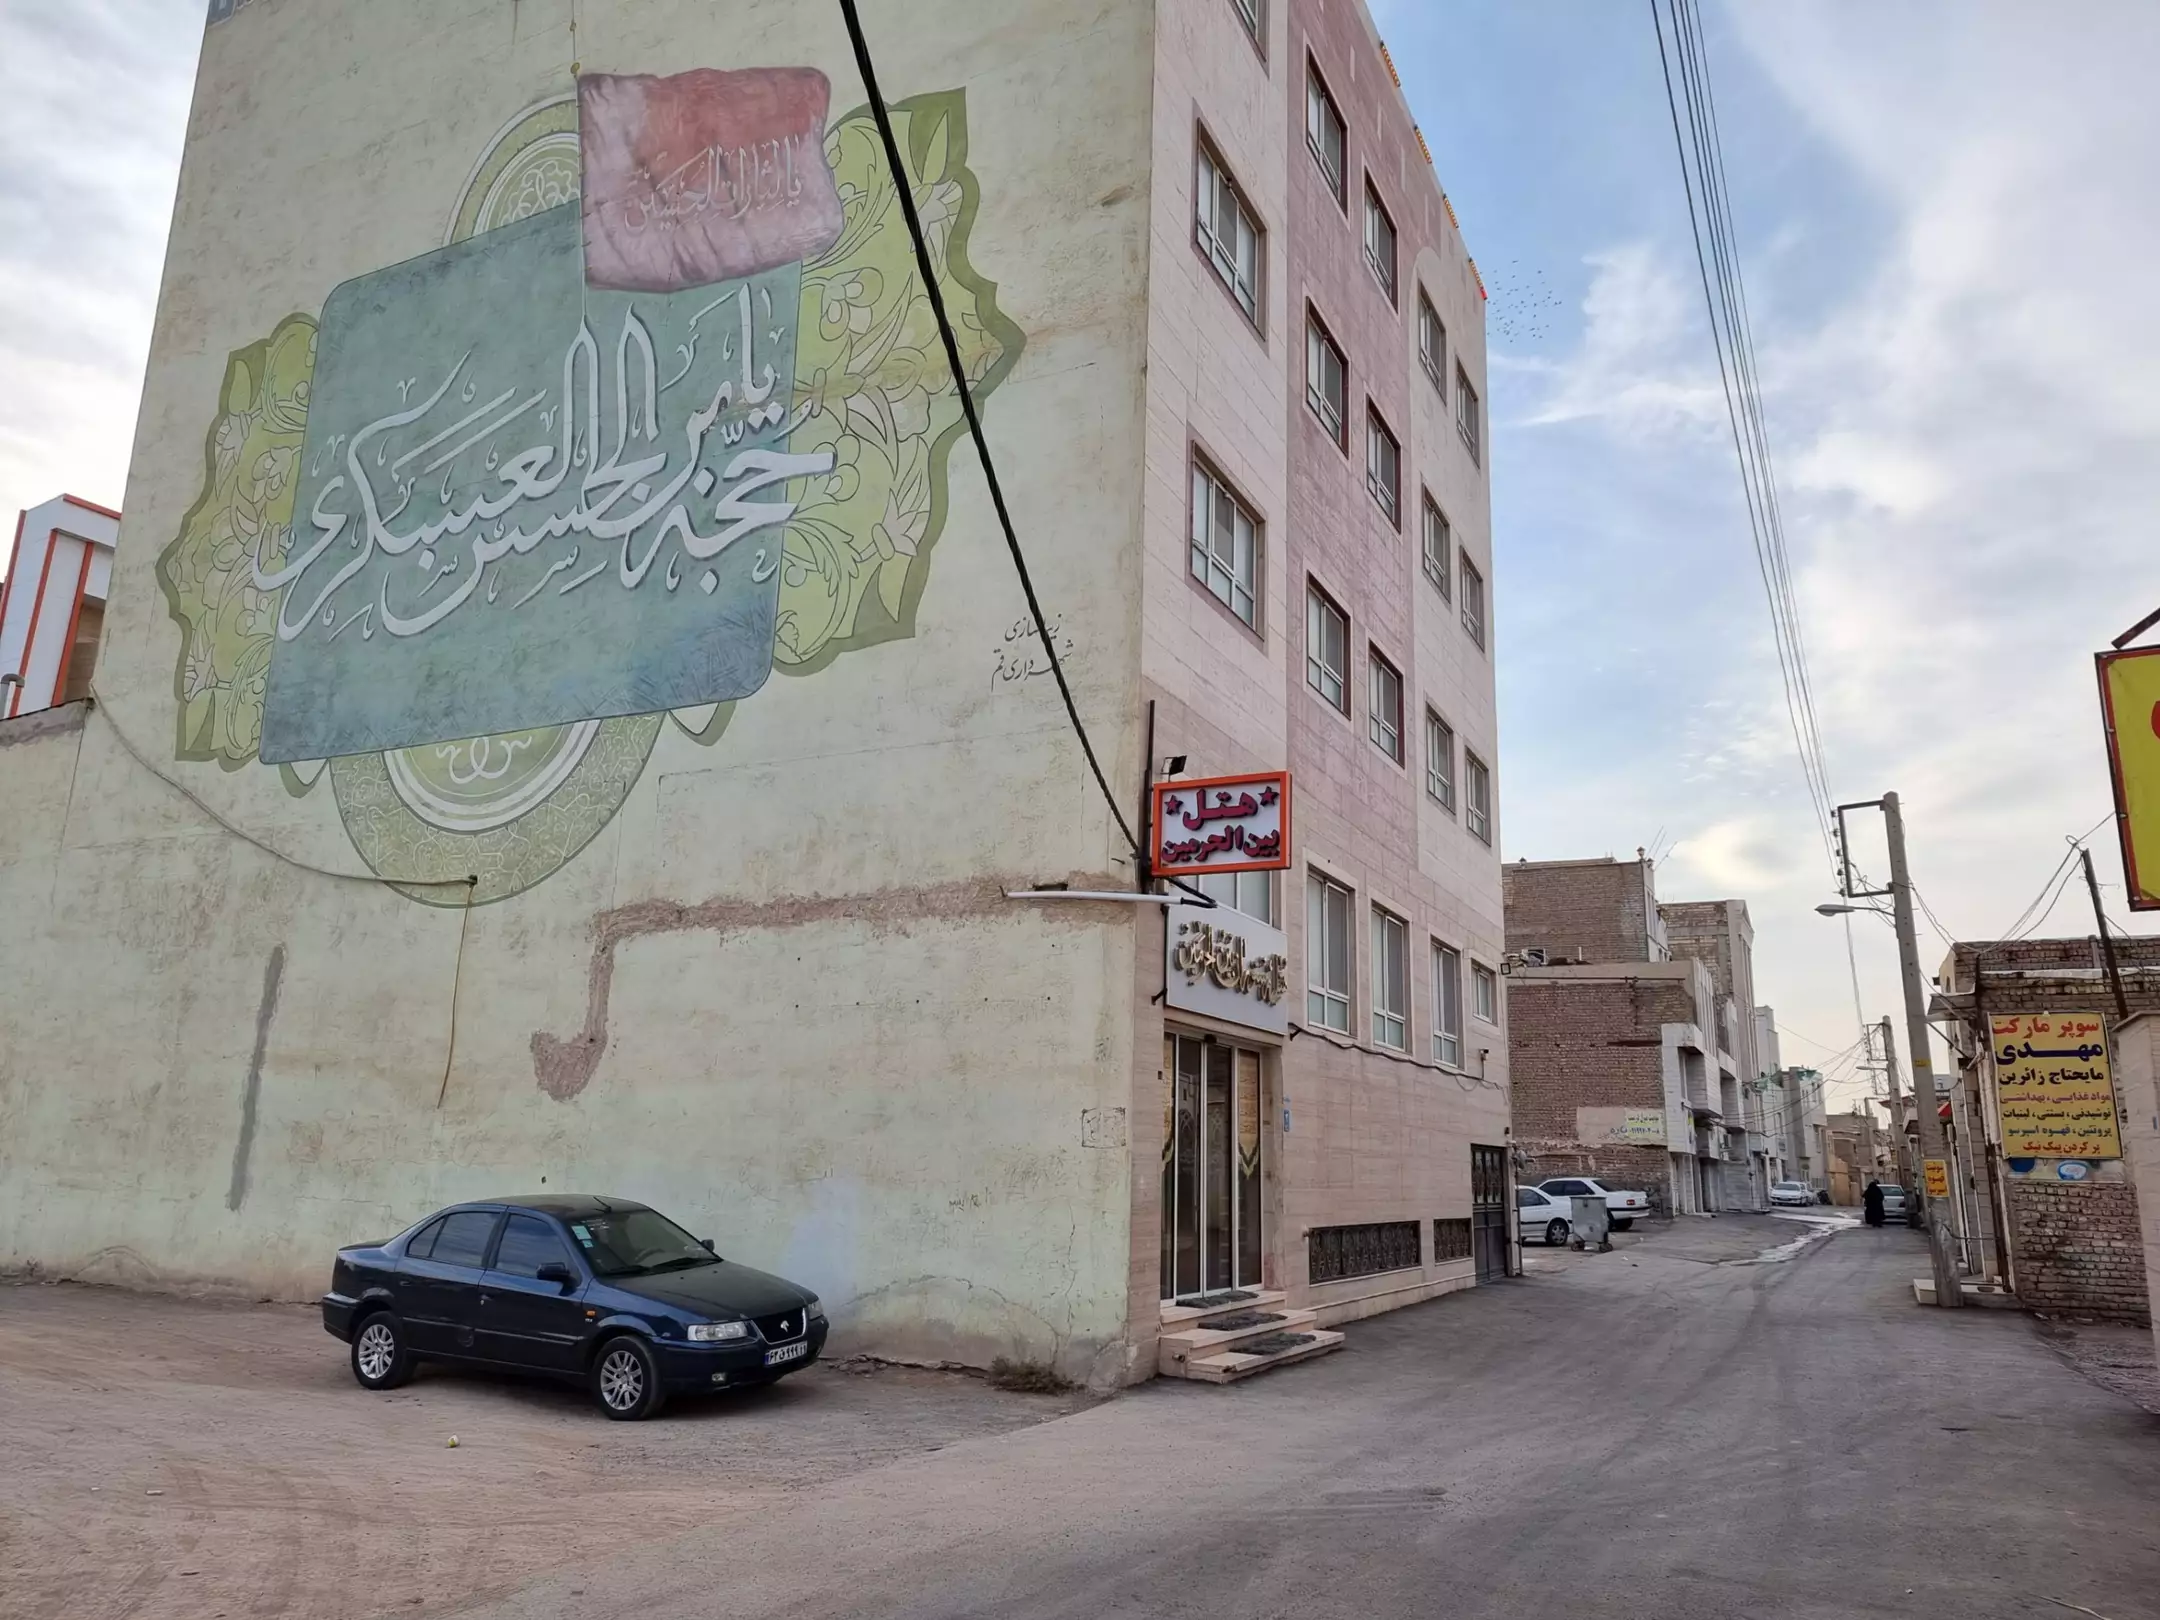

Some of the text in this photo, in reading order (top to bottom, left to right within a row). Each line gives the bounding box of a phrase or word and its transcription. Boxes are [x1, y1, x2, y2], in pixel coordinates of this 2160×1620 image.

[991, 649, 1004, 693] قم
[1183, 788, 1258, 831] هتل
[1162, 825, 1280, 863] بین الحرمین
[1993, 1016, 2099, 1038] سوپر مارکت
[1996, 1042, 2103, 1065] مهدی
[2000, 1067, 2104, 1085] مایحتاج زائرین
